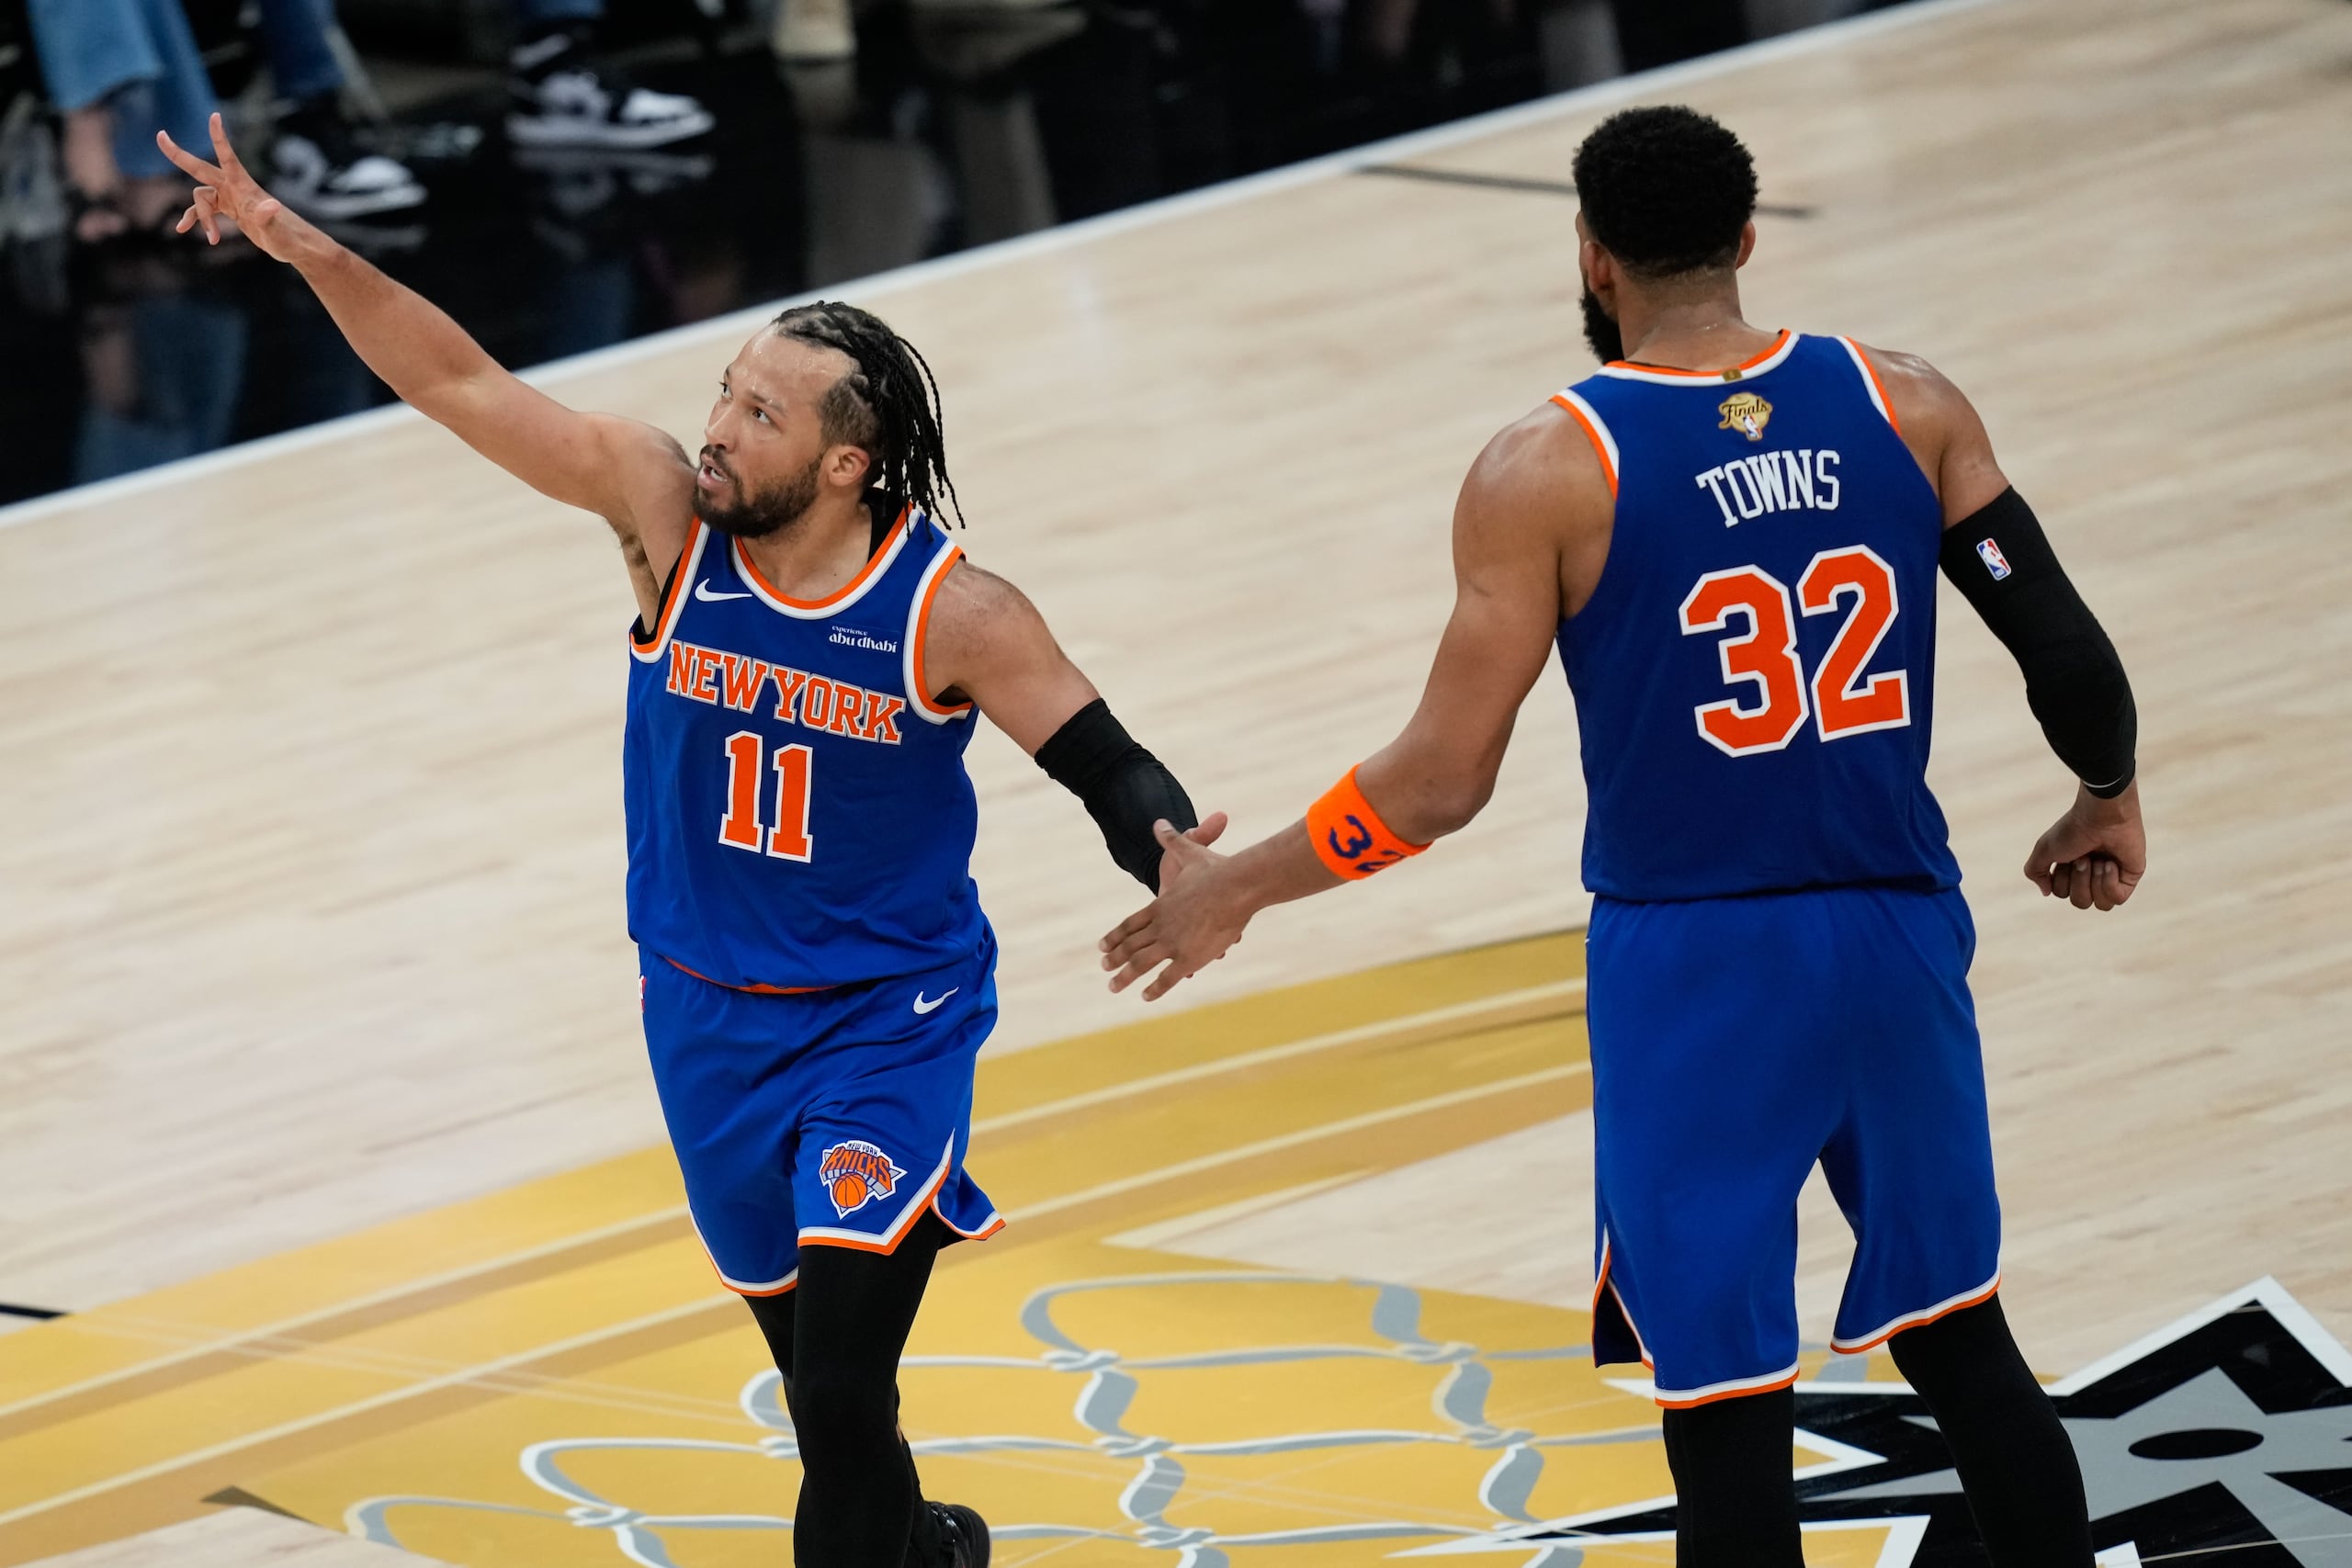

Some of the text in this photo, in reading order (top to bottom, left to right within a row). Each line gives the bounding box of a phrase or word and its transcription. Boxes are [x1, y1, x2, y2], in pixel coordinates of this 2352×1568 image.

[1721, 399, 1768, 425] Finals
[1695, 449, 1839, 528] TOWNS
[829, 633, 855, 646] abu
[831, 626, 868, 637] experience
[1679, 544, 1911, 758] 32
[666, 638, 907, 745] NEW YORK
[718, 730, 813, 863] 11
[820, 1145, 892, 1191] KNICKS
[846, 1143, 878, 1156] NEW YORK
